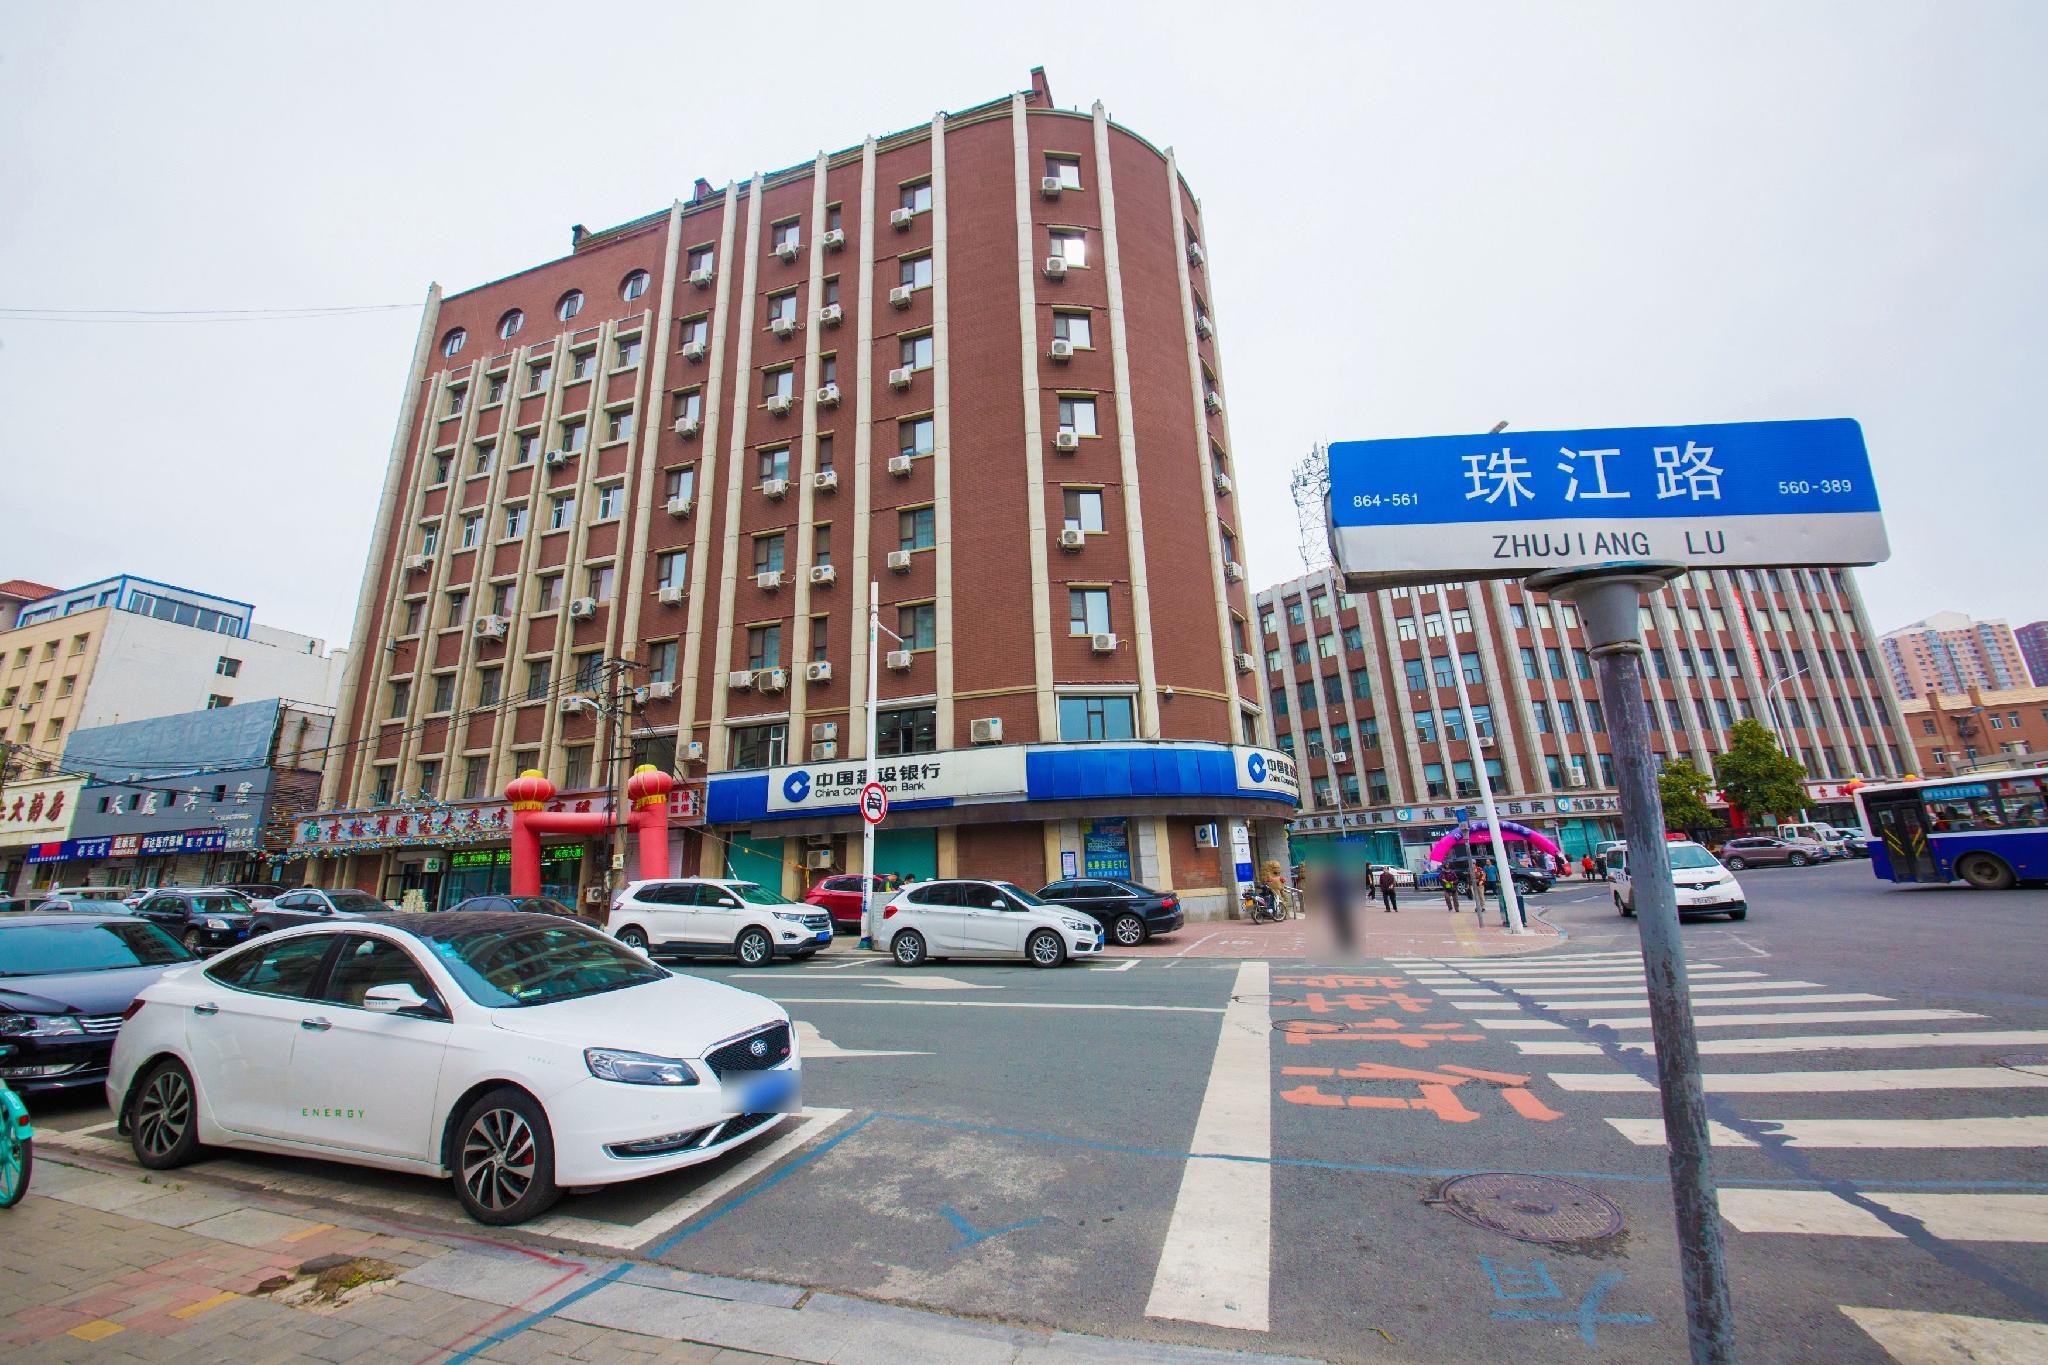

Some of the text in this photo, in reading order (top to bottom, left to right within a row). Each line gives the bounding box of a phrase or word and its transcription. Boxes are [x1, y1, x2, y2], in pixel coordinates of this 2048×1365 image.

[1461, 441, 1725, 508] 珠江路
[1778, 479, 1853, 495] 560-389
[1352, 492, 1419, 508] 864-561
[1492, 530, 1725, 559] ZHUJIANG LU
[815, 780, 926, 798] China Contion Bank
[301, 1107, 367, 1120] ENERGY
